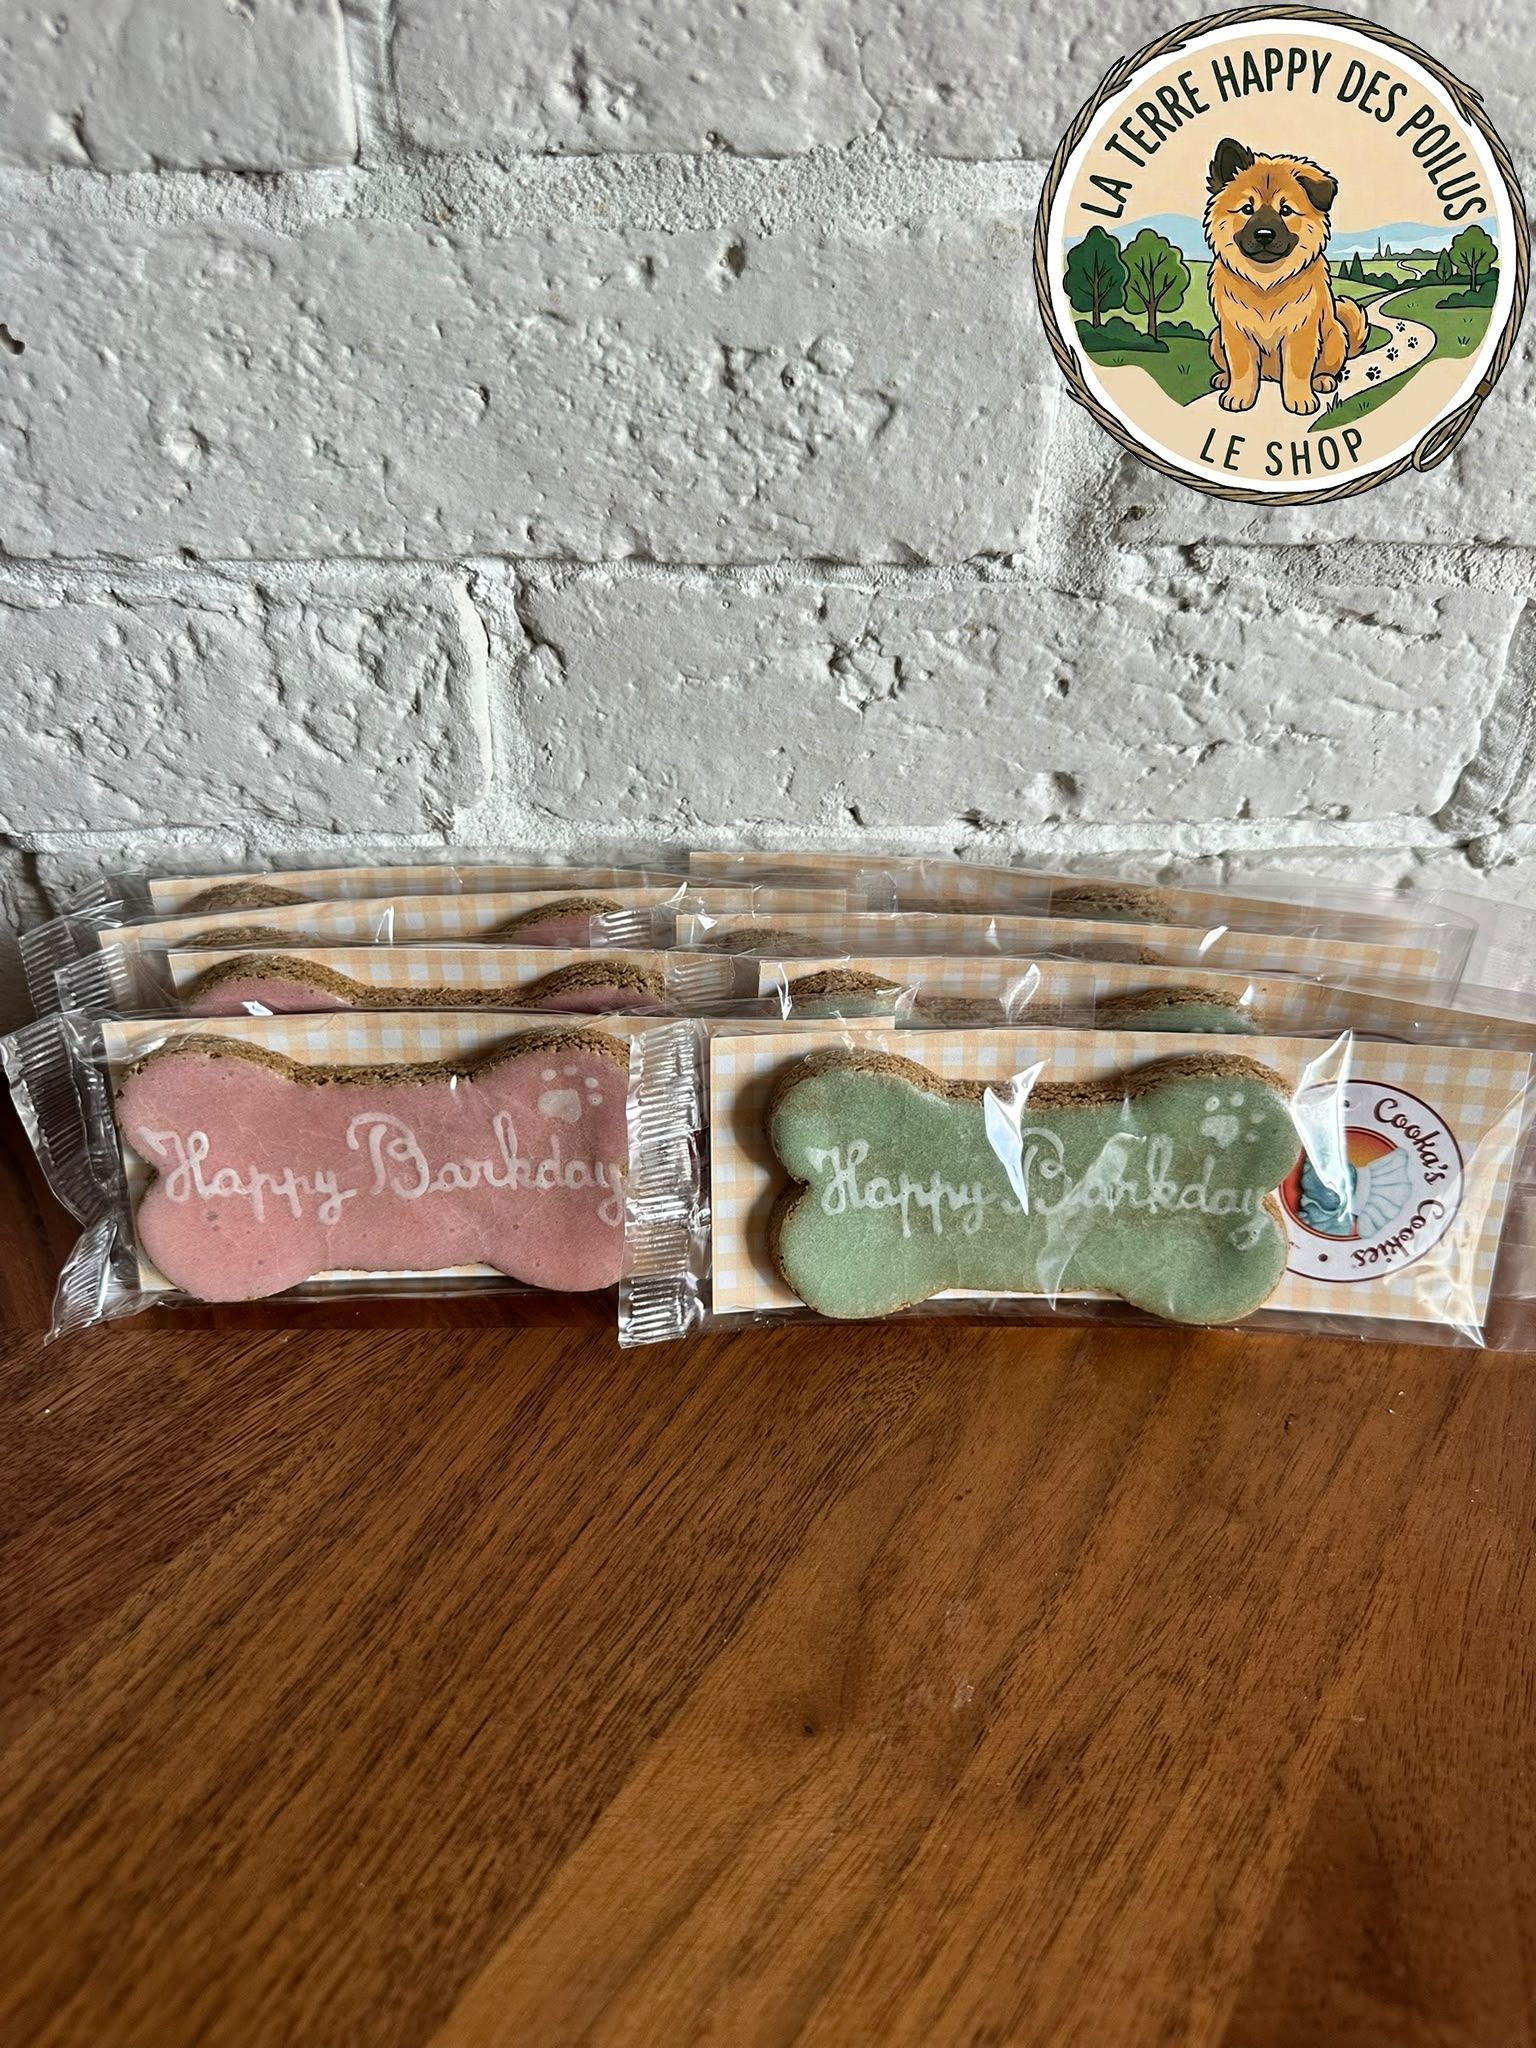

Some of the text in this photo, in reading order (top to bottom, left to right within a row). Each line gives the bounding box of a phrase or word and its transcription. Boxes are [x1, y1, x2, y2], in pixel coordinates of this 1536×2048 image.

[138, 1110, 625, 1226] Happy Barkday
[807, 1138, 998, 1238] Happy
[1350, 1097, 1449, 1268] Cooka's Cookies
